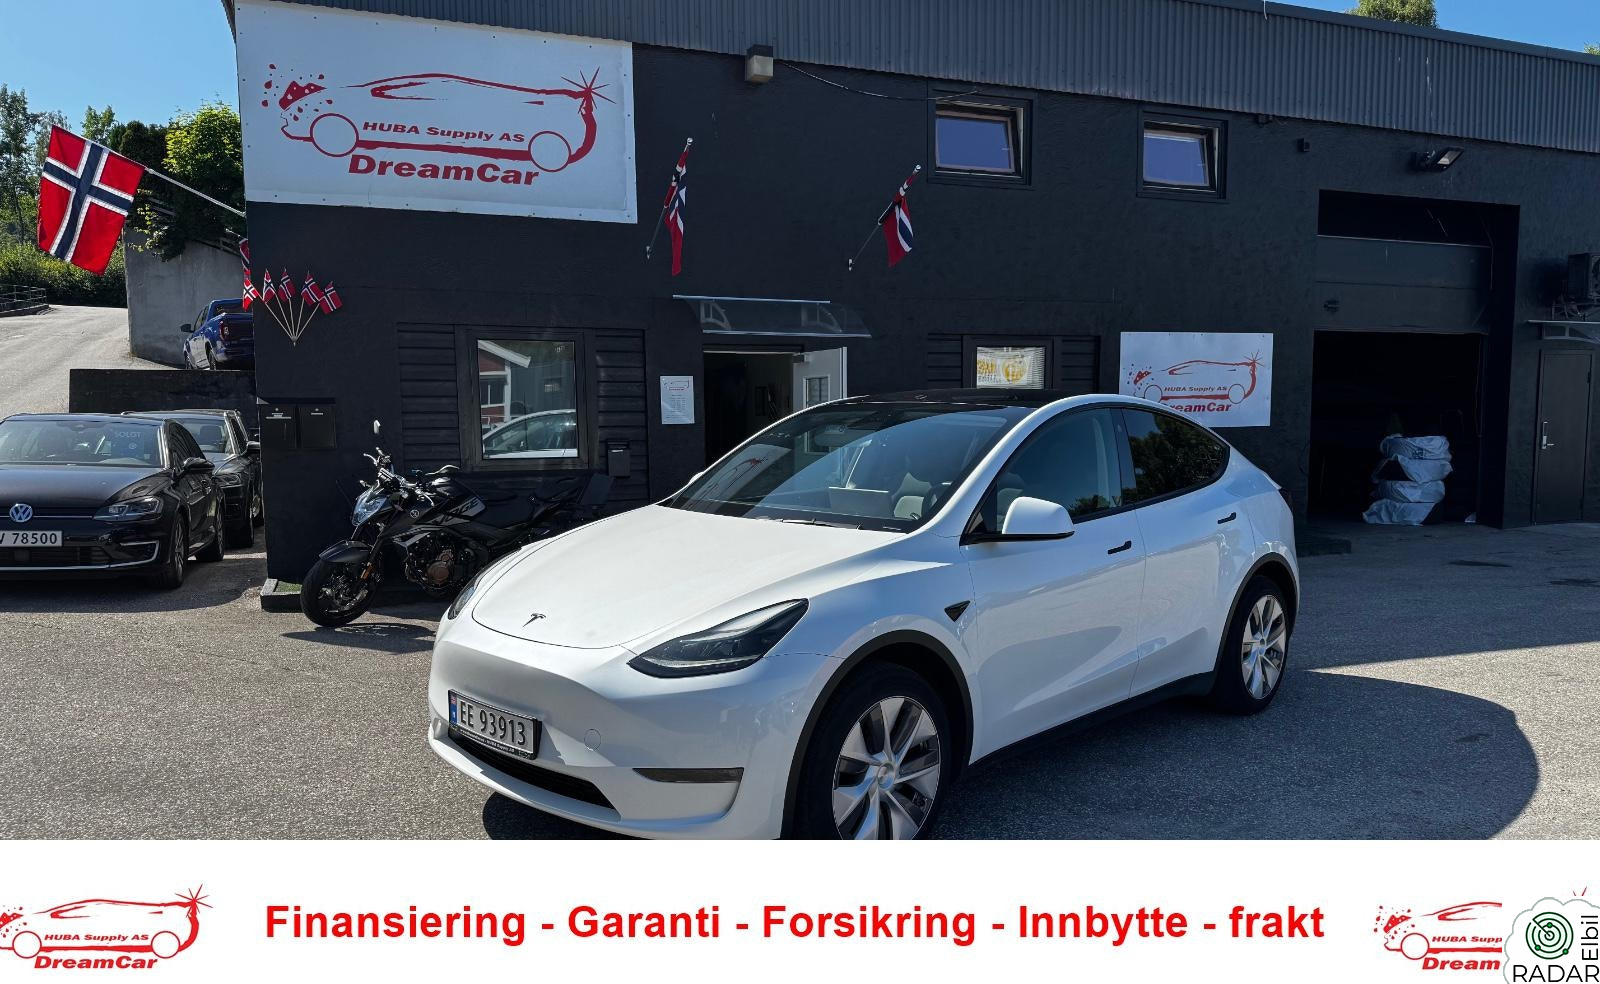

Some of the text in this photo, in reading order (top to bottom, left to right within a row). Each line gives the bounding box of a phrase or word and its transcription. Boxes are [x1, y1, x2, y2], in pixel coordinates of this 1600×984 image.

[362, 121, 525, 143] HUBA Supply AS
[348, 154, 540, 186] DreamCar
[12, 532, 57, 545] 78500
[460, 701, 474, 728] EE
[480, 708, 526, 746] 93913
